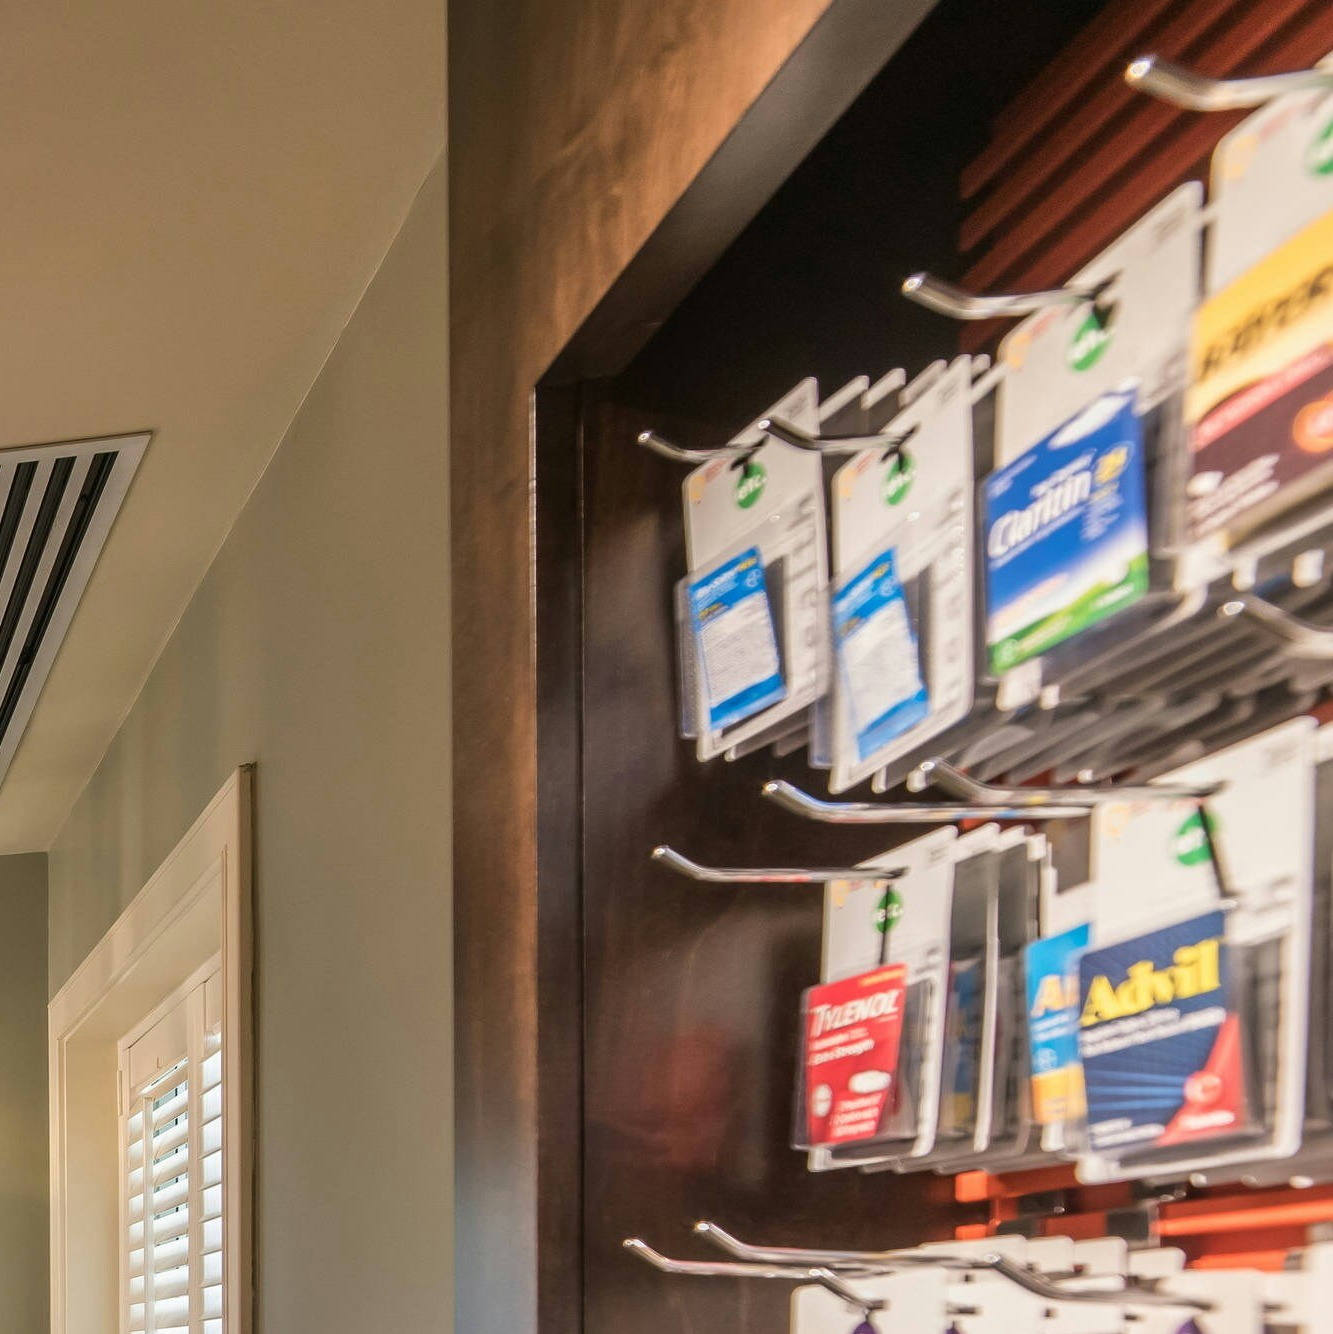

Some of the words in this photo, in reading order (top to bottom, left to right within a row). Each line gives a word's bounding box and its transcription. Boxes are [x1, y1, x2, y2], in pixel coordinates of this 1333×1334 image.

[988, 470, 1092, 558] Claritin
[811, 989, 900, 1037] TYLENOL
[1080, 939, 1221, 1027] Advil
